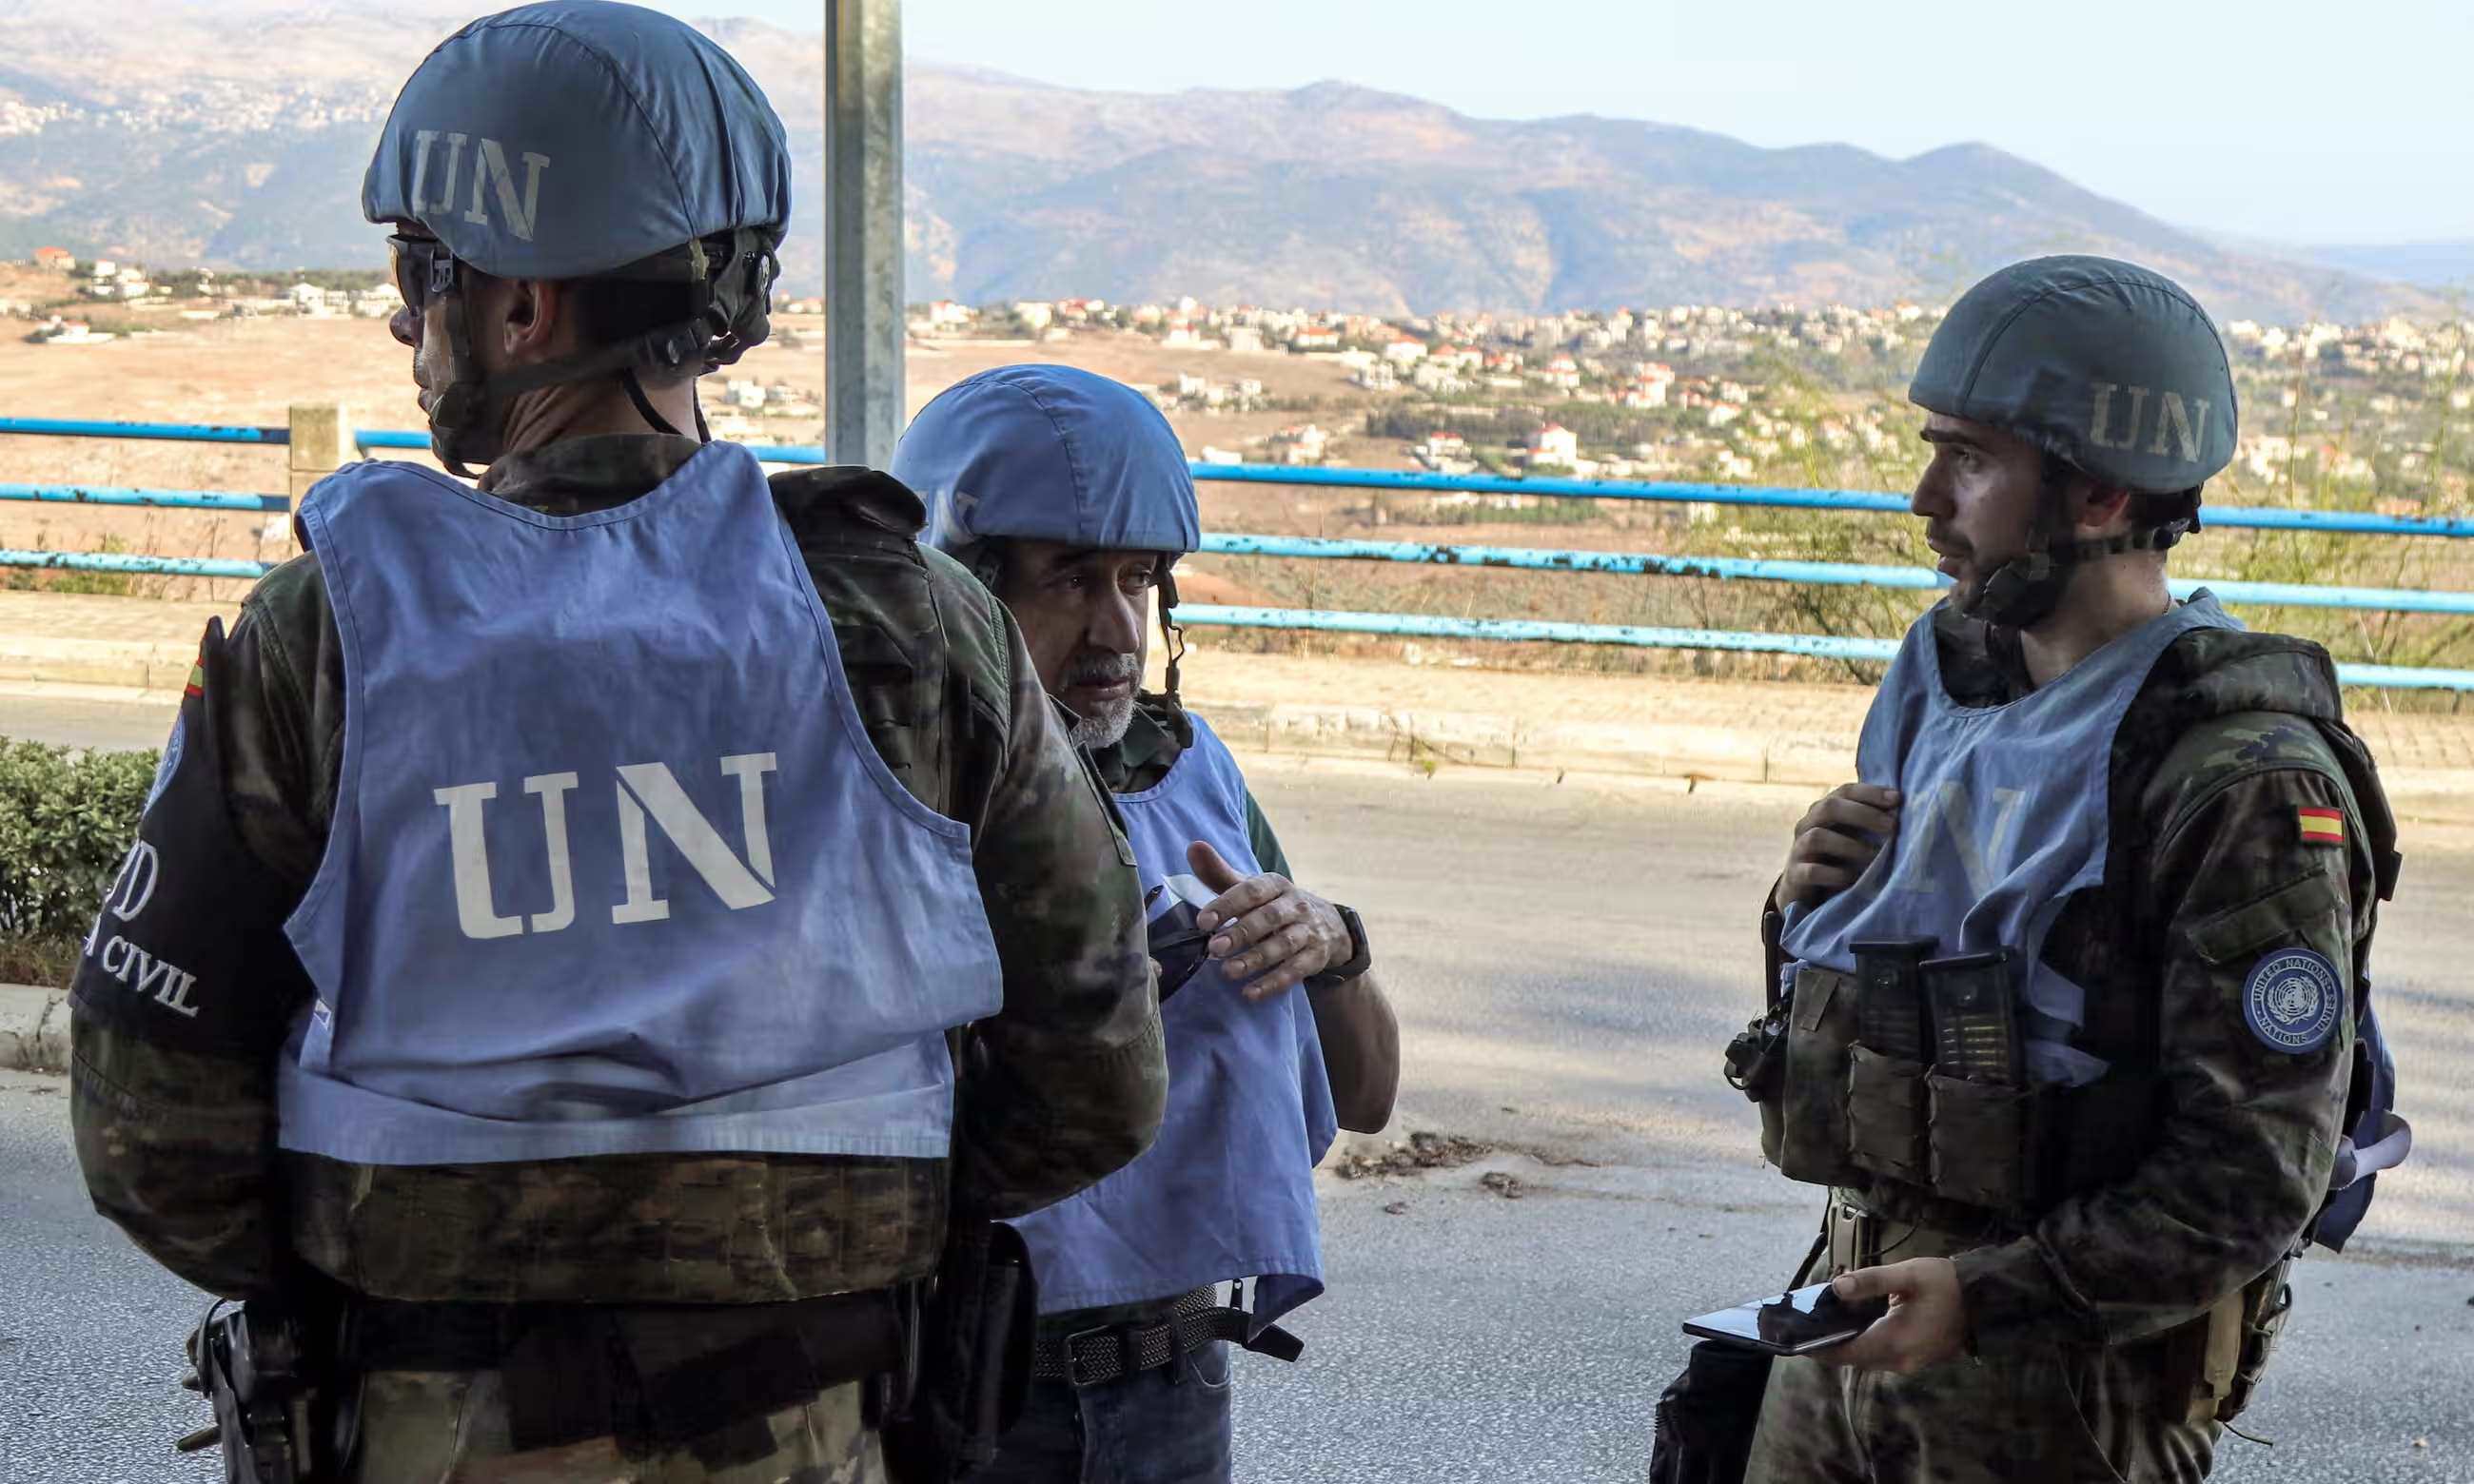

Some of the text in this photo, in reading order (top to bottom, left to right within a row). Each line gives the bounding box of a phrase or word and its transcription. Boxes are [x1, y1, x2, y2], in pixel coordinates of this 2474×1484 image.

[411, 129, 550, 242] UN
[2090, 382, 2210, 463] UN
[434, 752, 777, 939] UN
[103, 935, 200, 1018] CIVIL
[2253, 959, 2330, 1002] UNITED NATIONS
[2259, 994, 2335, 1044] NATIONS UNIES
